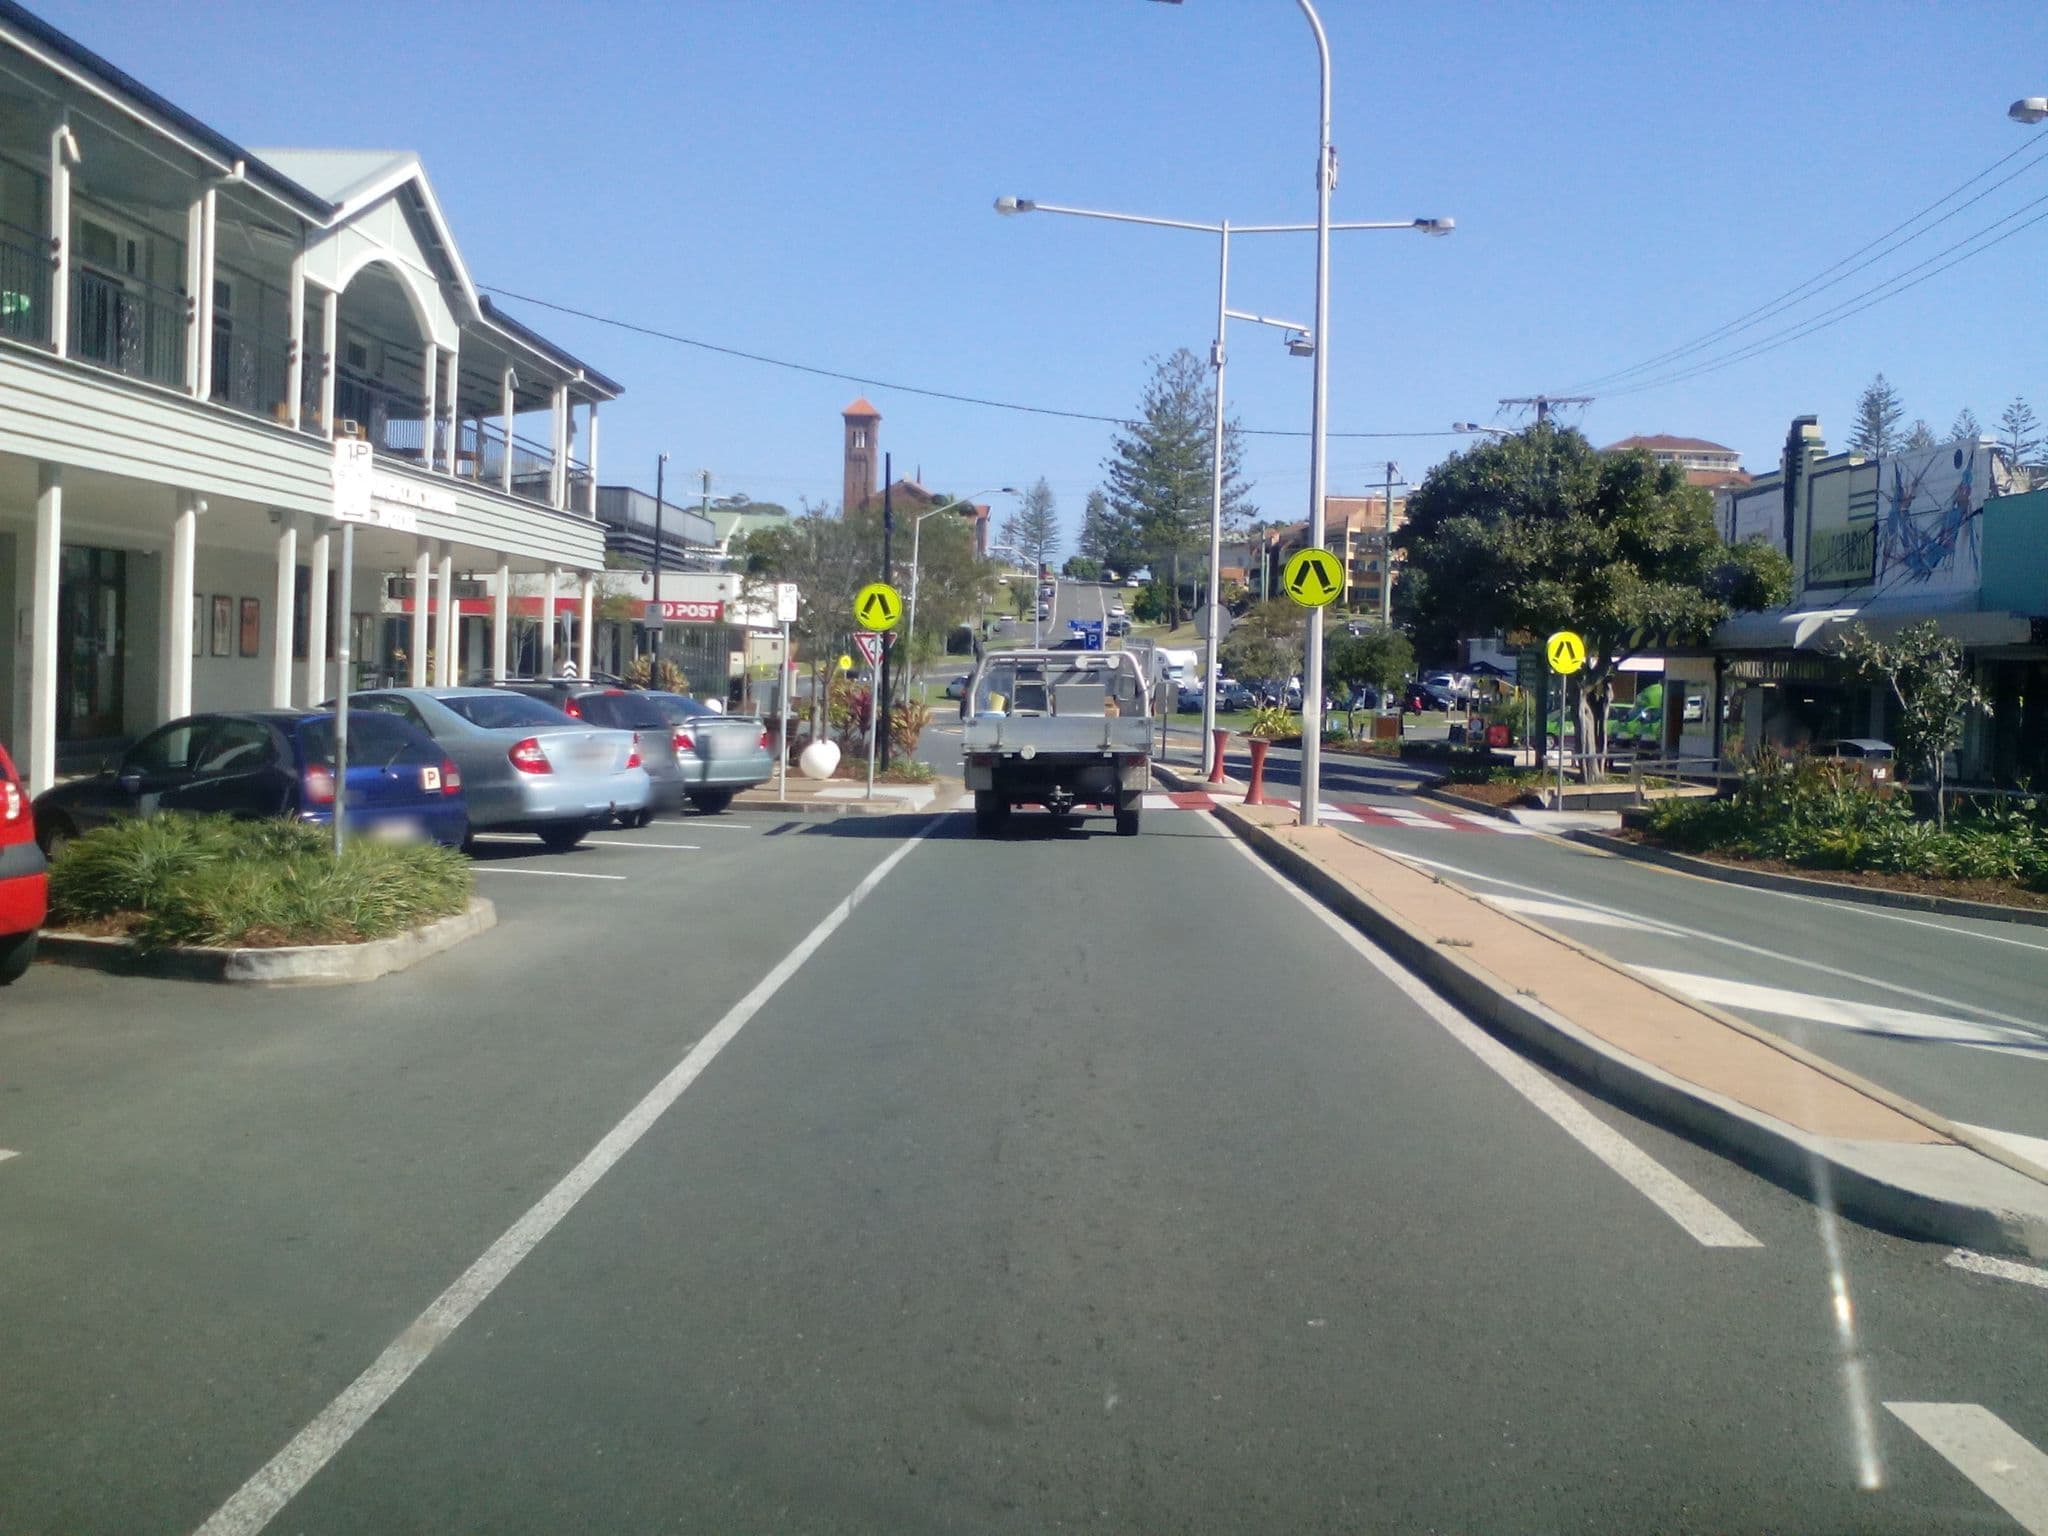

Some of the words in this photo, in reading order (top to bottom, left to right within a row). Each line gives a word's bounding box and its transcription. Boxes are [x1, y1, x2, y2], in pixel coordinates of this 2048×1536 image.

[676, 604, 719, 618] POST
[1088, 634, 1098, 646] P
[427, 771, 436, 785] P
